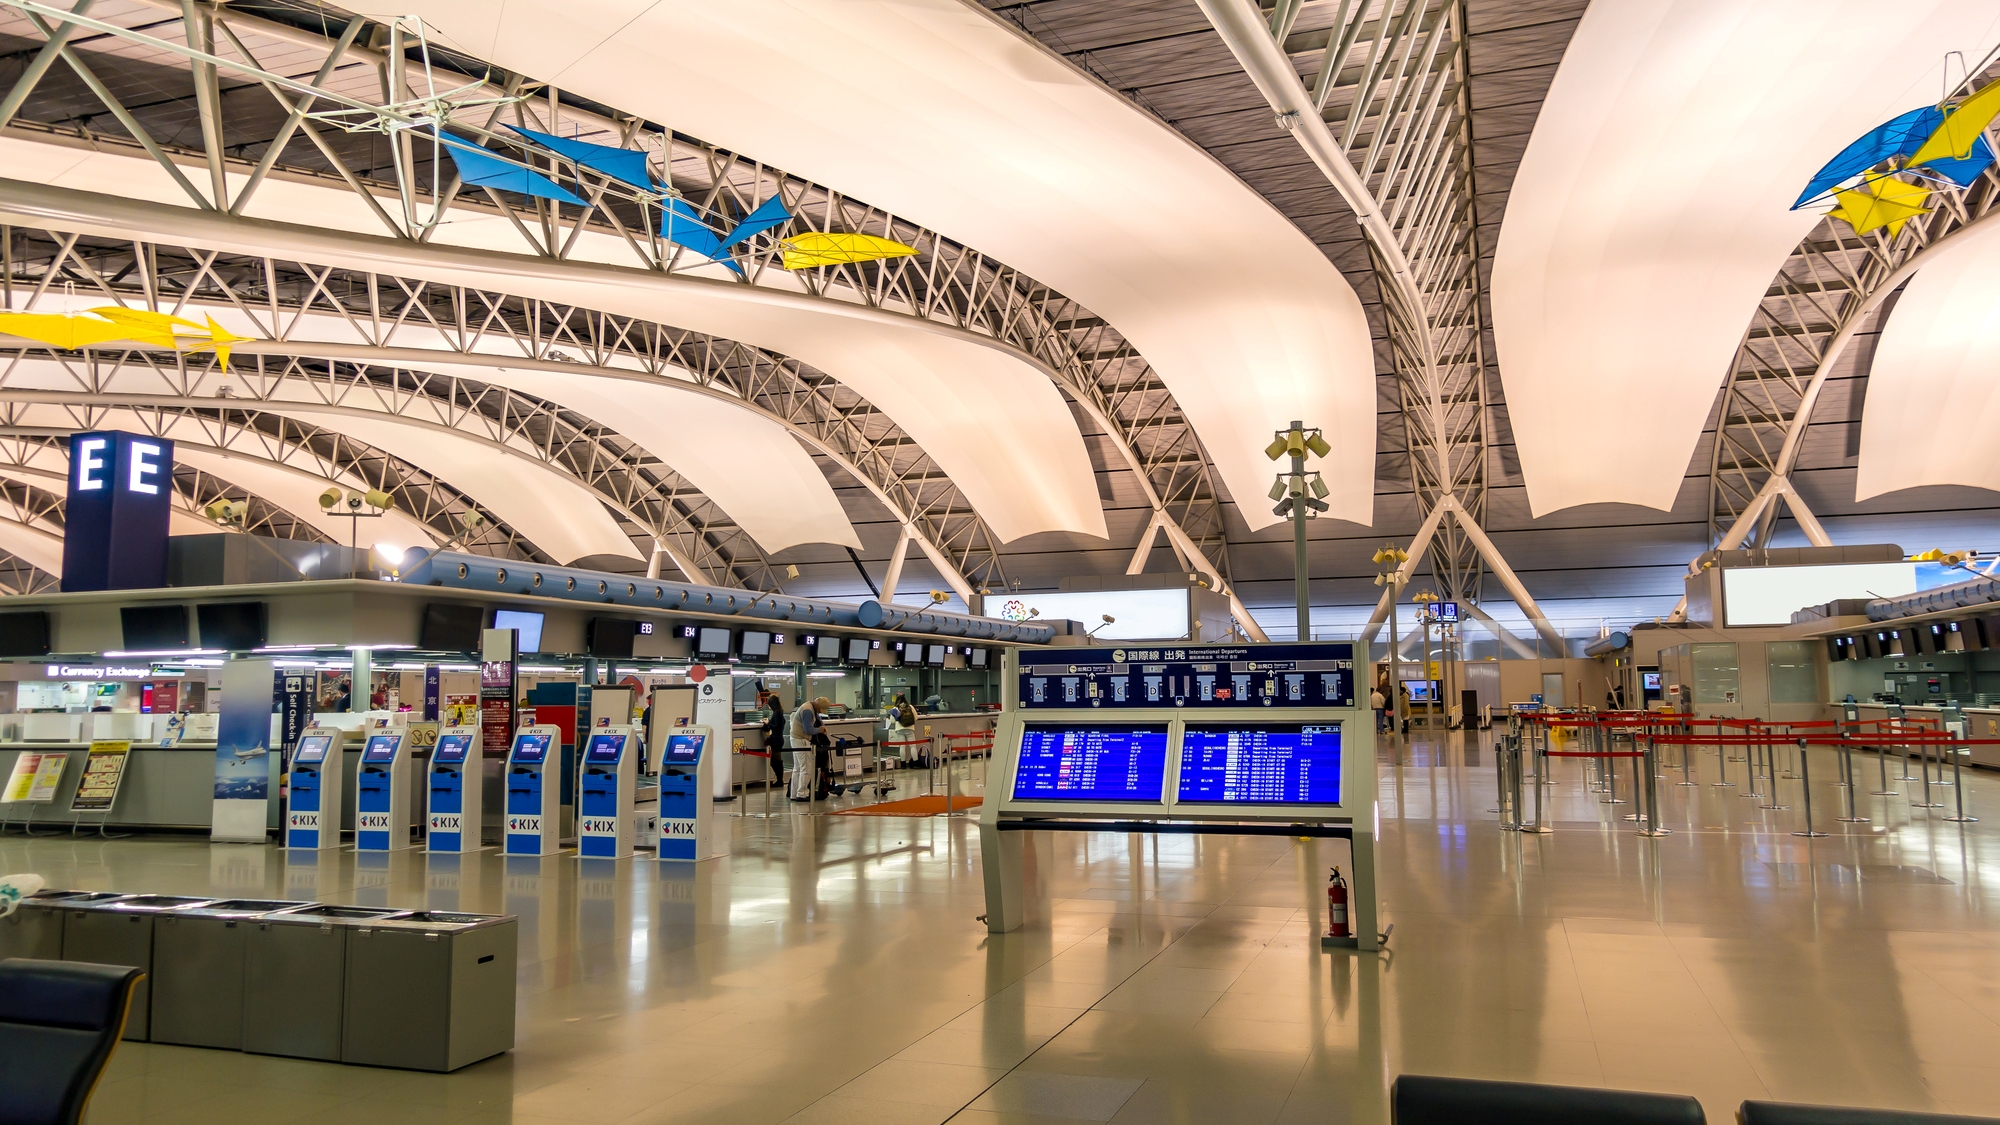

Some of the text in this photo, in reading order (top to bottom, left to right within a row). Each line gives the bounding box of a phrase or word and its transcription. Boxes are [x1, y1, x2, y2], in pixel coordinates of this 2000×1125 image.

[79, 439, 105, 490] E
[129, 441, 160, 494] E
[641, 623, 652, 634] E13
[685, 627, 695, 637] E14
[1128, 650, 1160, 661] 国際線
[1164, 650, 1186, 660] 出発
[60, 667, 150, 678] Currency Exchange
[1035, 688, 1042, 696] A
[1067, 687, 1074, 696] B
[1116, 686, 1123, 696] C
[1150, 686, 1157, 695] D
[1203, 685, 1209, 694] E
[1238, 685, 1244, 694] F
[1290, 685, 1298, 694] G
[1327, 685, 1335, 694] H
[289, 709, 297, 740] Check-in
[299, 815, 317, 826] KIX
[369, 816, 388, 827] KIX
[440, 817, 460, 828] KIX
[519, 819, 540, 830] KIX
[594, 820, 615, 832] KIX
[672, 822, 694, 834] KIX
